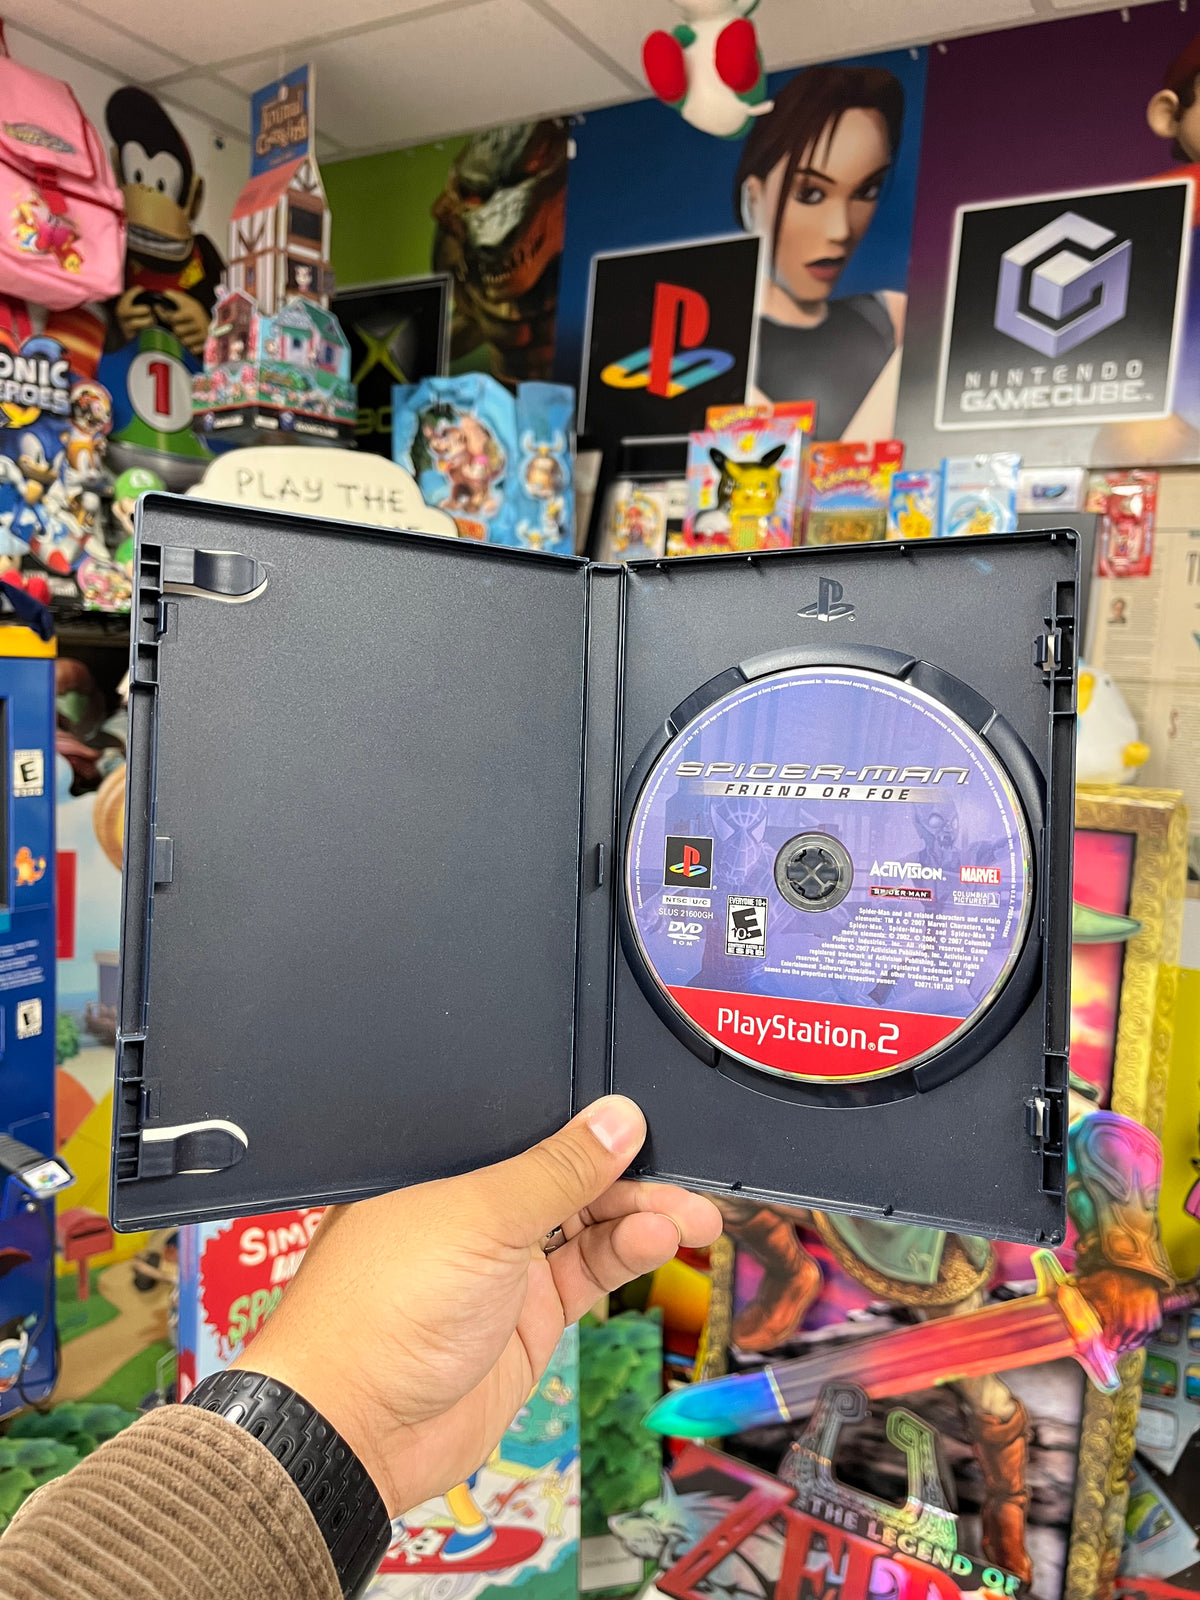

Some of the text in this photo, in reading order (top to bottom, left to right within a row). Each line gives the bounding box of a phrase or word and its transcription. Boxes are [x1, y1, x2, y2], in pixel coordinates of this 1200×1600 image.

[0, 352, 69, 389] ONIC
[965, 359, 1143, 389] NINTENDO
[148, 361, 170, 416] 1
[236, 468, 405, 514] PLAY THE
[724, 784, 911, 800] FRIEND OR FOE
[961, 867, 999, 884] MARVEL
[665, 896, 708, 906] NTSC U/C
[953, 891, 987, 899] COLUMBIA
[953, 897, 987, 905] PICTURES
[658, 907, 714, 920] SLUS 21600GH
[668, 921, 703, 934] DVD
[808, 1495, 859, 1529] THE
[867, 1520, 973, 1577] LEGEND
